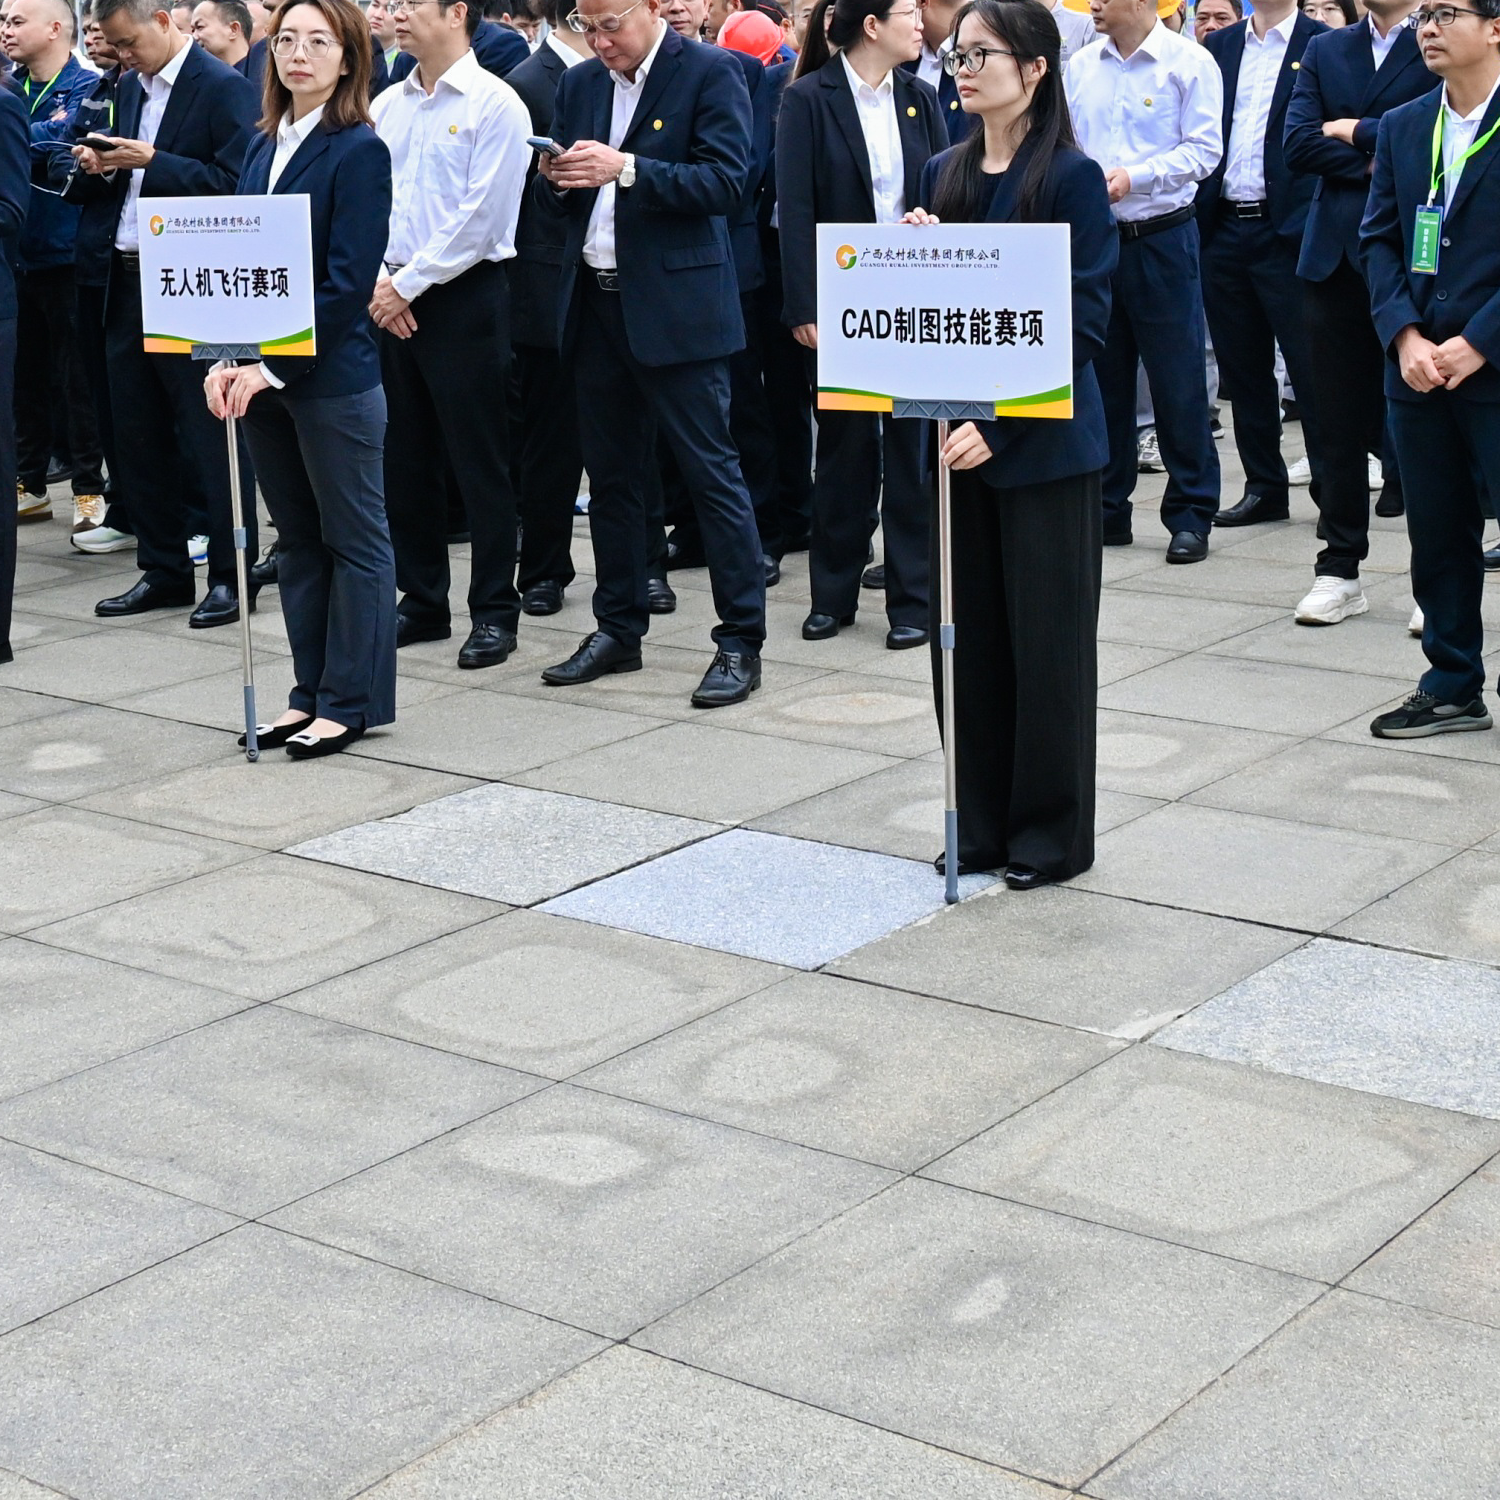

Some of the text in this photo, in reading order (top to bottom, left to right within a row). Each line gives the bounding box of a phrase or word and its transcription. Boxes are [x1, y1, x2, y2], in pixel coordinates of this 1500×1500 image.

[166, 215, 261, 228] 广西农村投资集团有限公司
[860, 247, 1000, 262] 广西农村投资集团有限公司
[160, 266, 289, 298] 无人机飞行赛项
[841, 307, 1044, 346] CAD制图技能赛项
